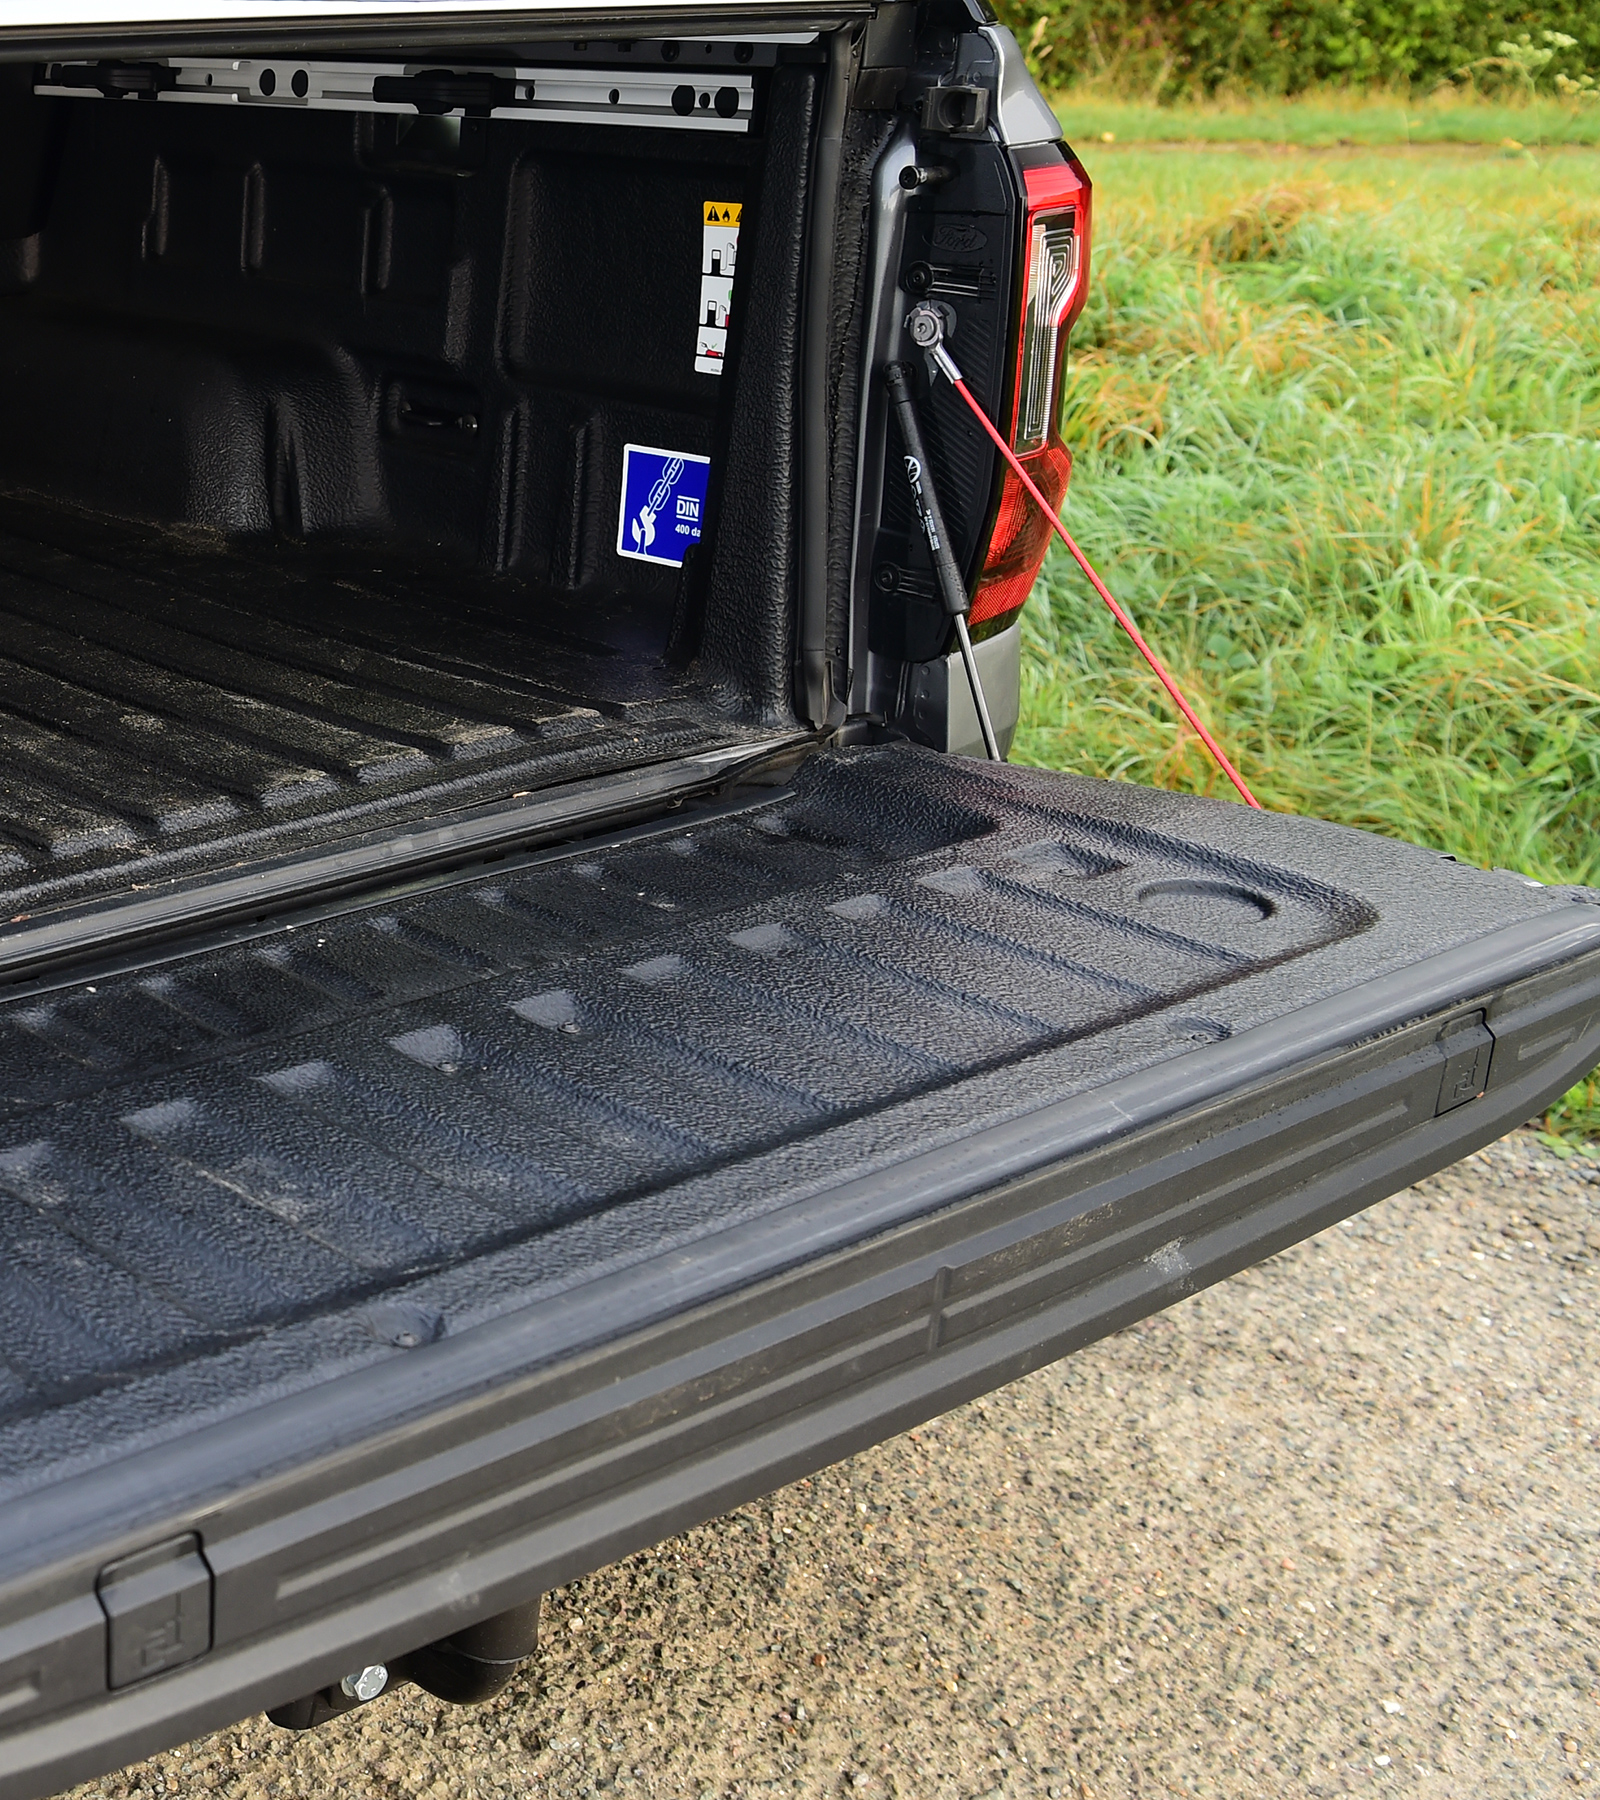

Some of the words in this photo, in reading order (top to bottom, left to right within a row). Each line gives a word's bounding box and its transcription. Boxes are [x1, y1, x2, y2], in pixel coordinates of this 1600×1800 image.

[934, 226, 977, 250] Ford
[676, 499, 699, 518] DIN
[675, 524, 690, 535] 400
